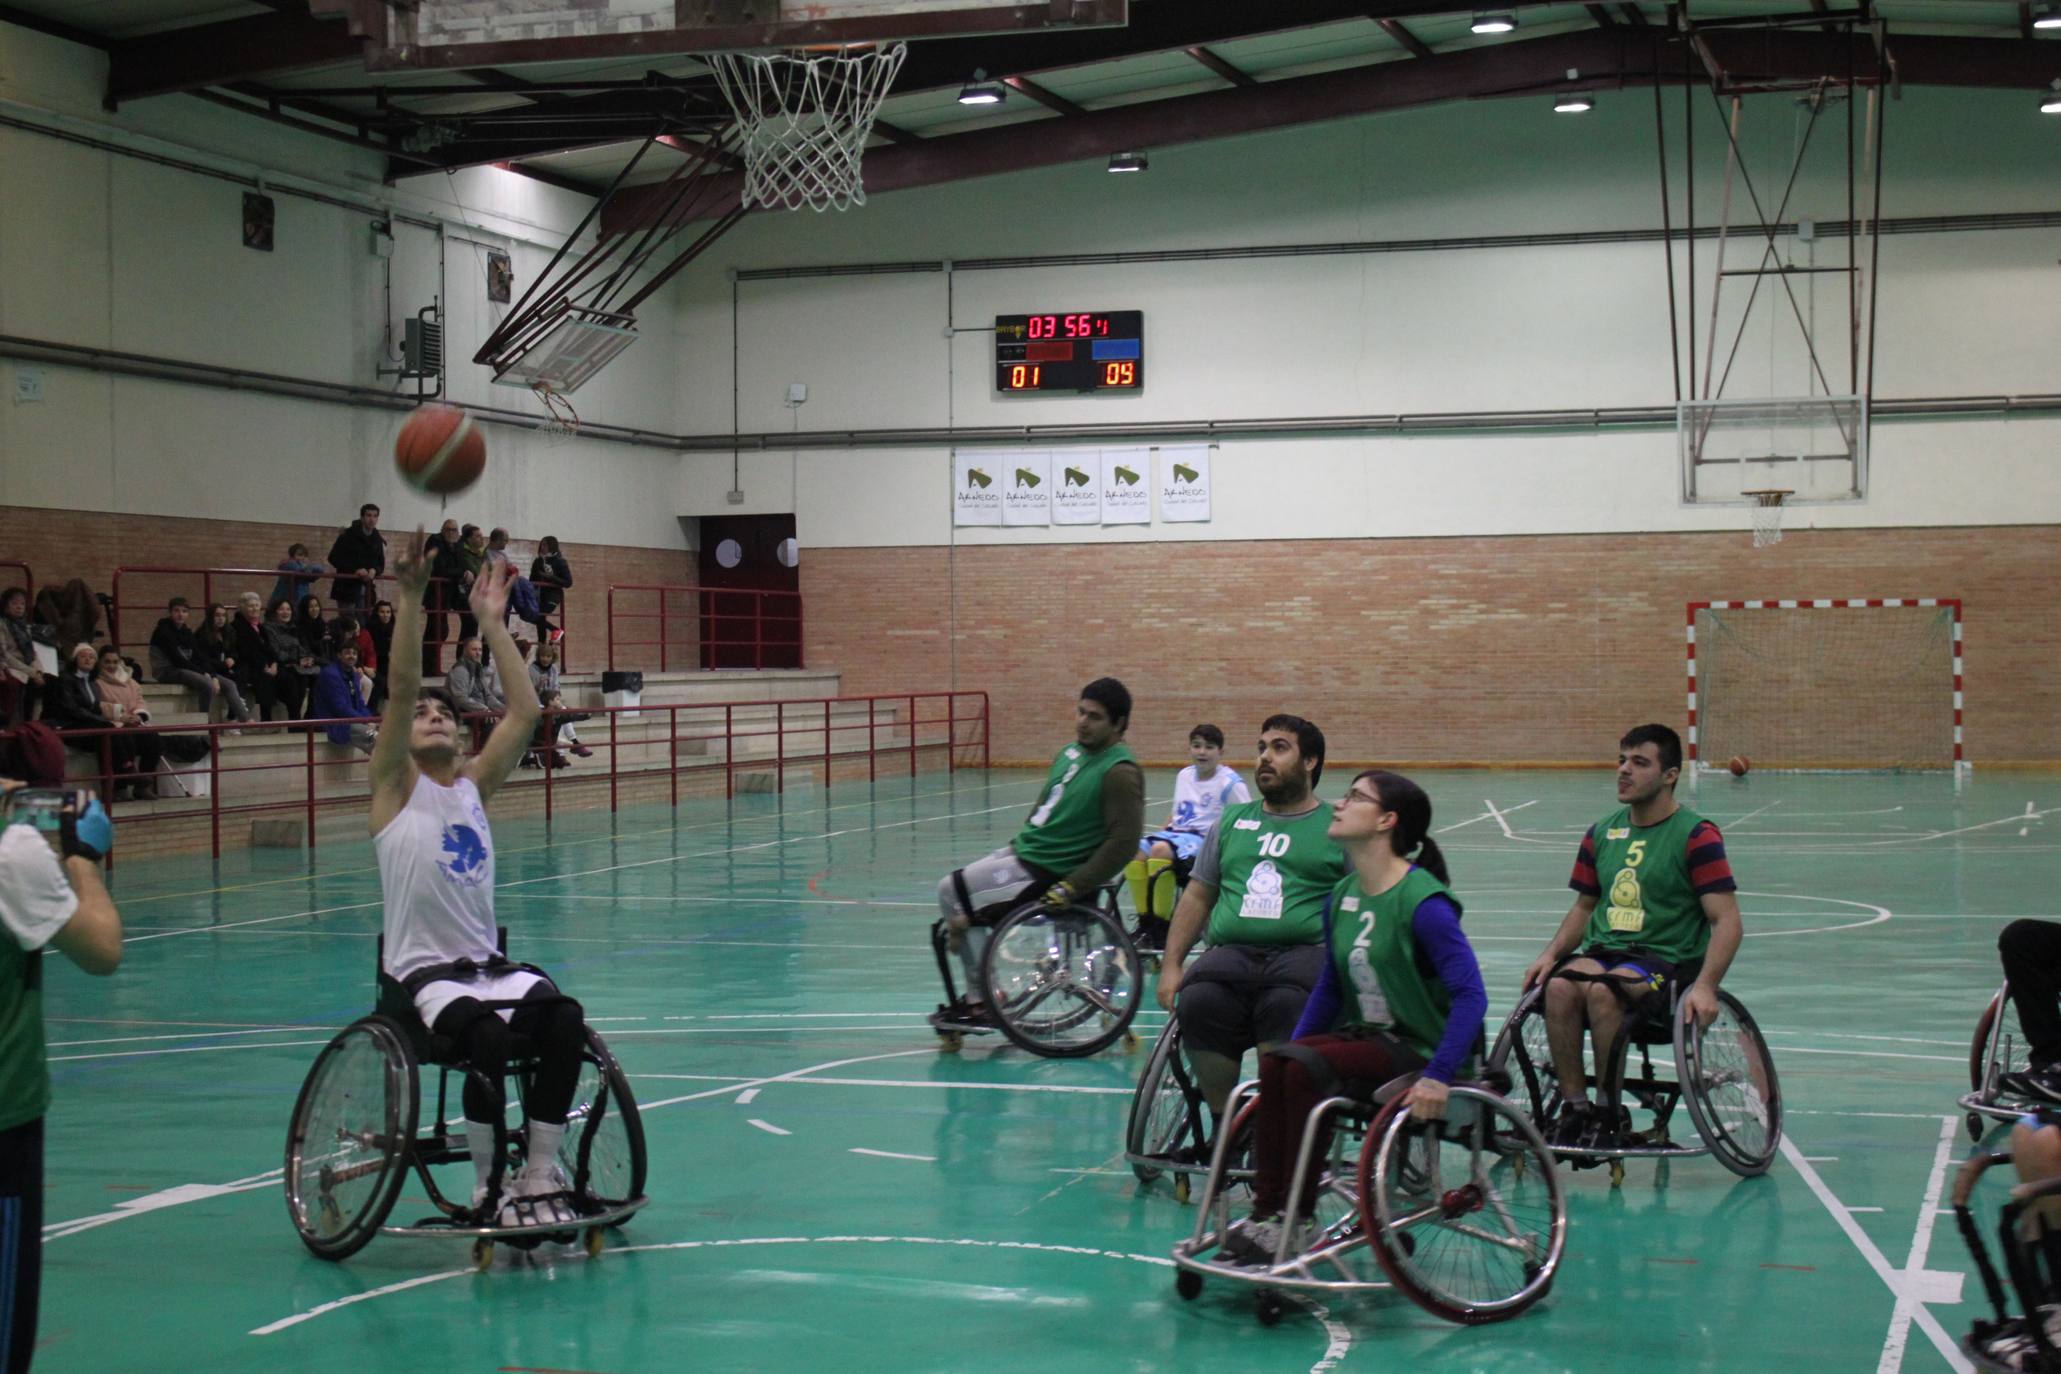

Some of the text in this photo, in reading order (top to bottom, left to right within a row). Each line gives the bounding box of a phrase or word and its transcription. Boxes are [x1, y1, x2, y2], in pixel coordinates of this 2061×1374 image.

[1028, 316, 1056, 339] 03
[1064, 314, 1091, 337] 56
[1012, 365, 1040, 388] 01
[1106, 362, 1134, 386] 09
[1256, 832, 1291, 857] 10
[1625, 840, 1647, 867] 5
[1353, 910, 1376, 947] 2
